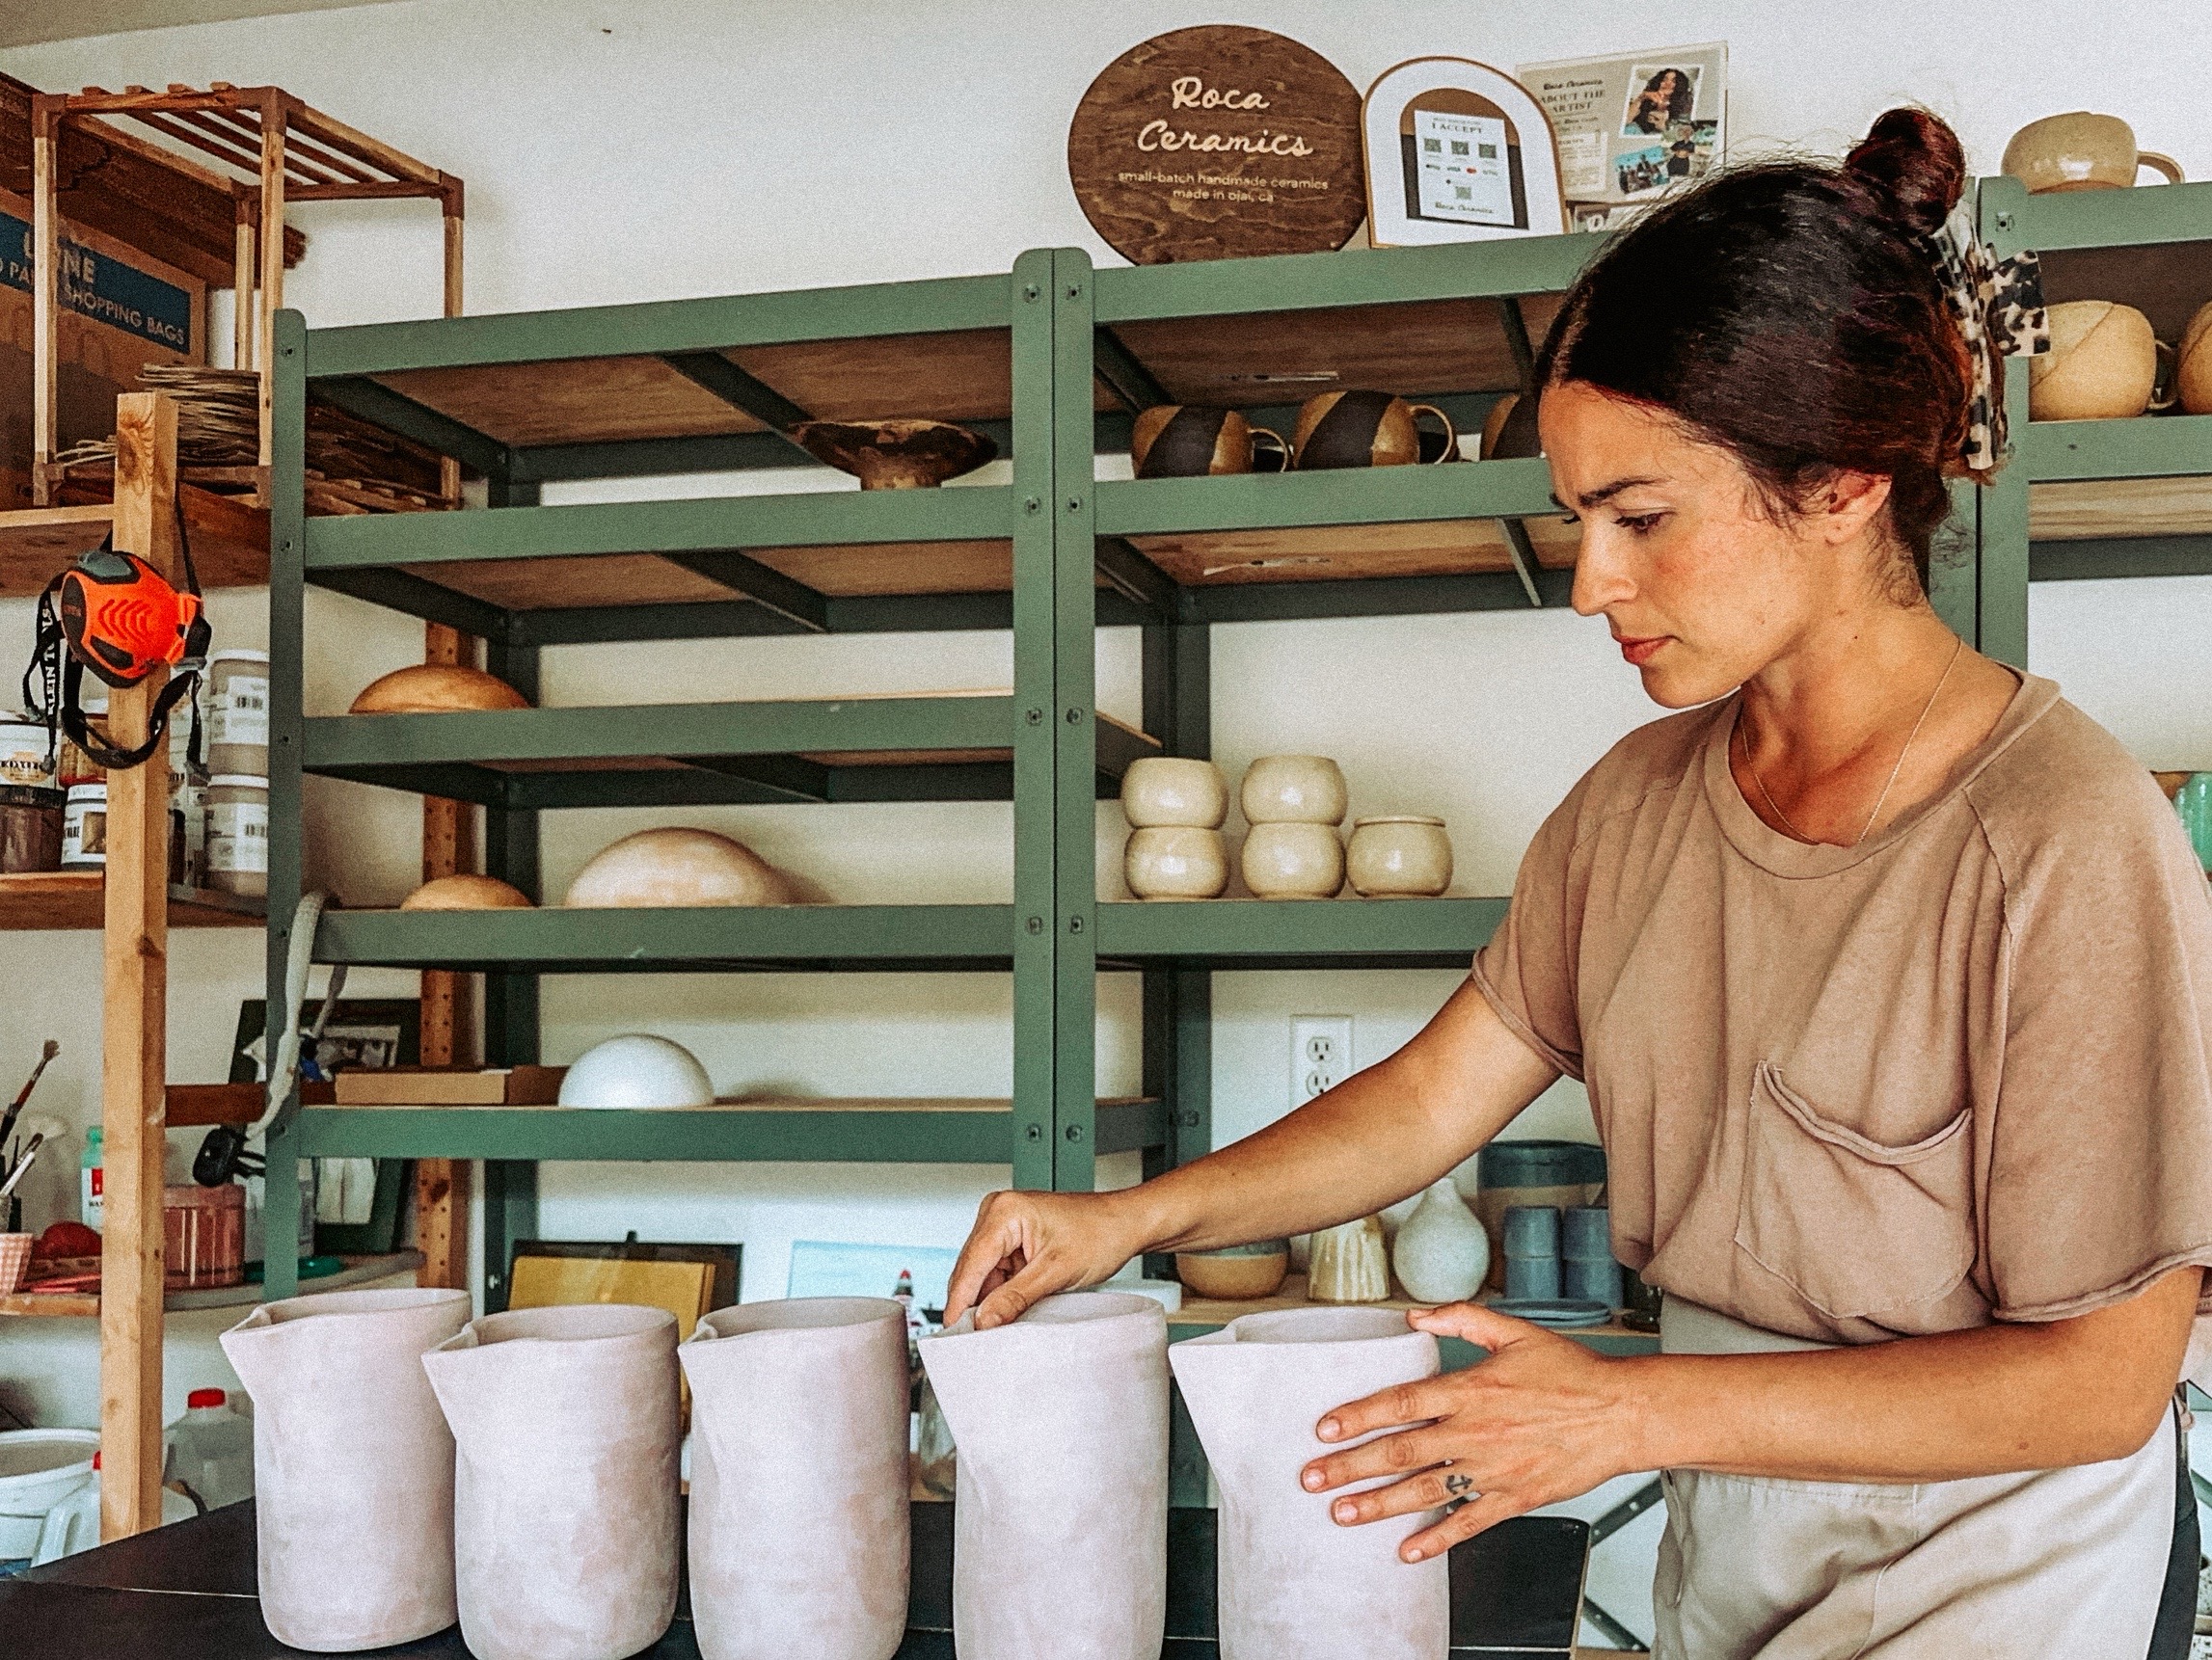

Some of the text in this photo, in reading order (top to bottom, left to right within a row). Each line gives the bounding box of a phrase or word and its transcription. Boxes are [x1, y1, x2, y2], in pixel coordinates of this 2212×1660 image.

[1171, 76, 1271, 110] Roca
[1552, 100, 1592, 113] ARTIST
[1137, 118, 1314, 158] Ceramics
[1119, 170, 1329, 191] small-batch handmade ceramics
[1173, 188, 1210, 201] made
[1213, 188, 1225, 201] in
[65, 282, 185, 345] SHOPPING BAGS
[45, 665, 56, 715] KLEIN
